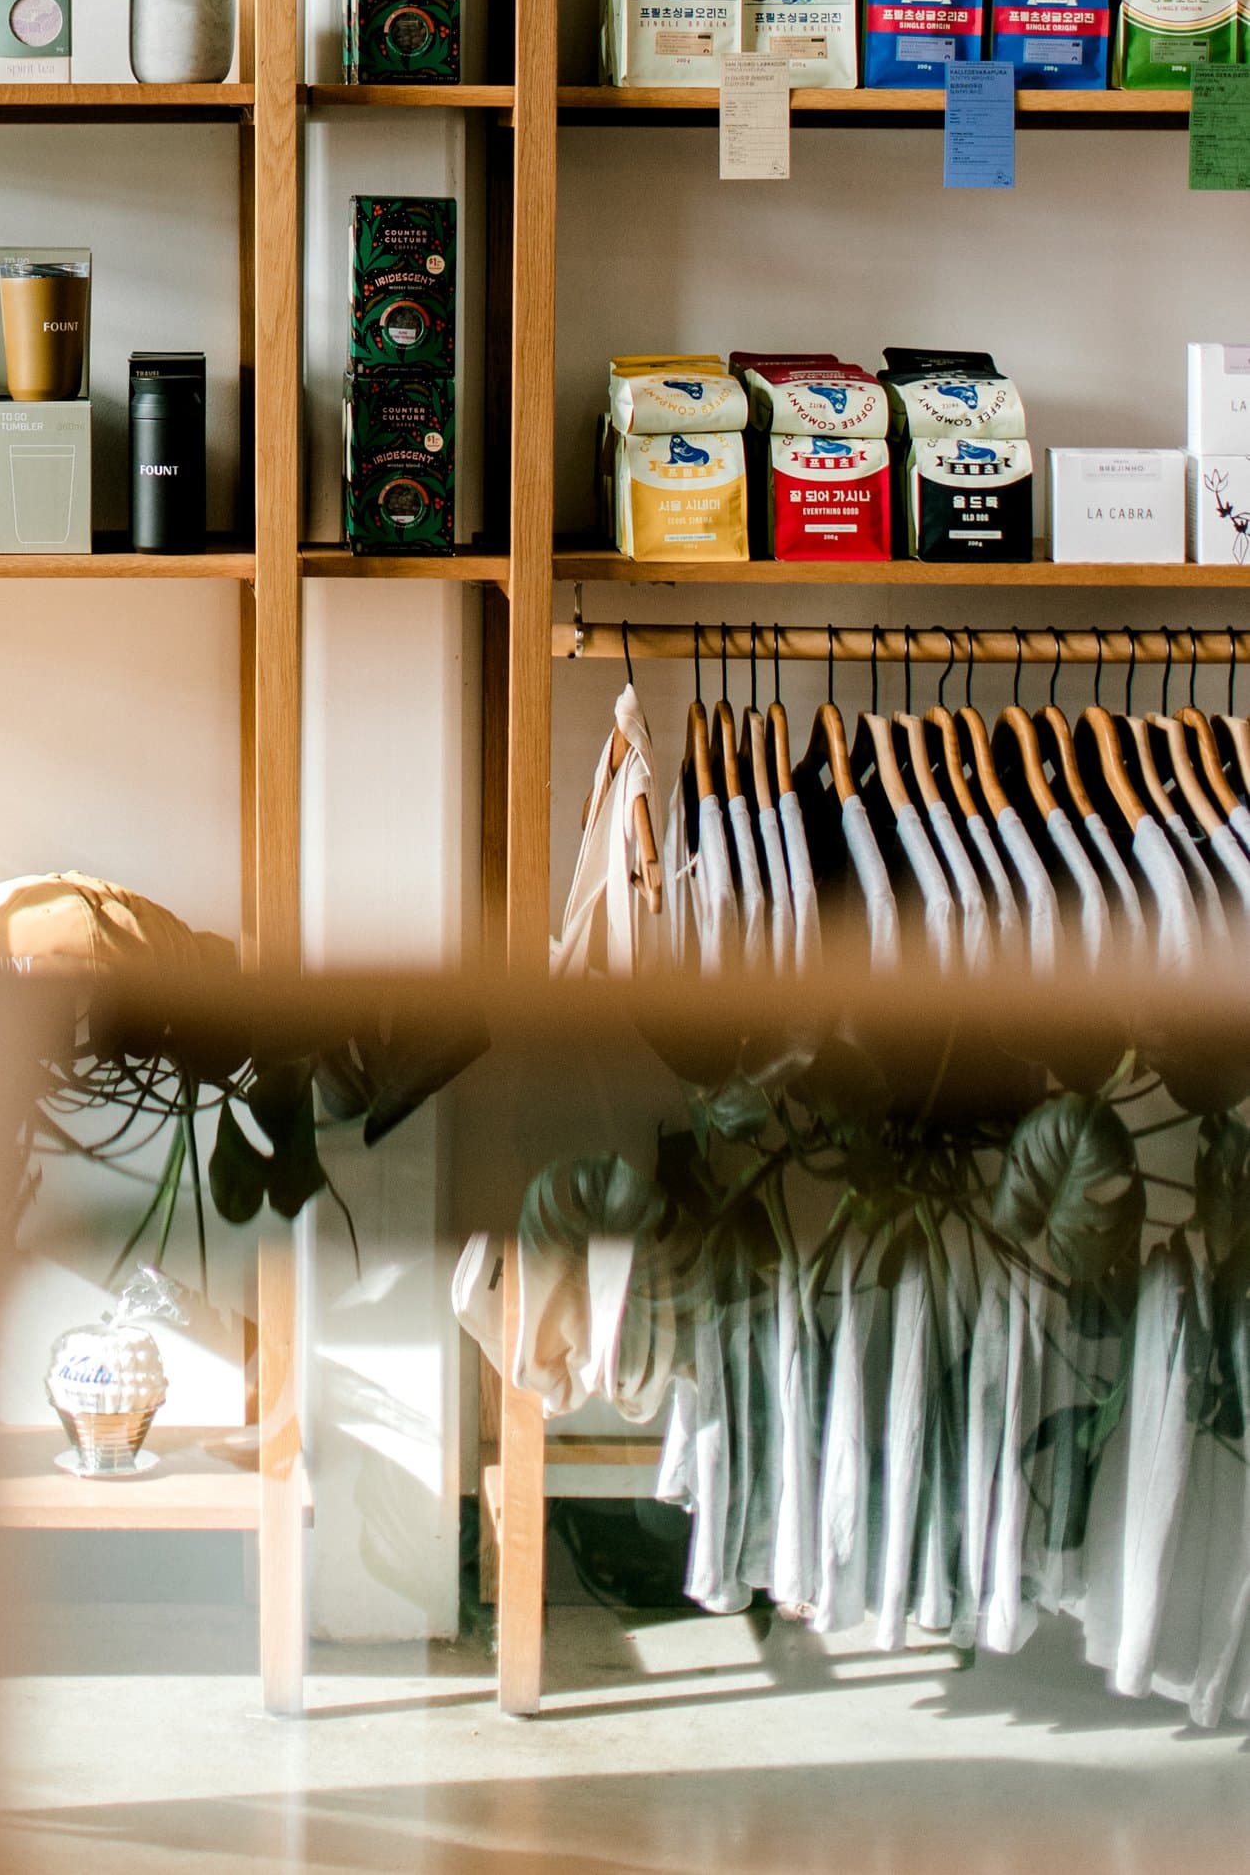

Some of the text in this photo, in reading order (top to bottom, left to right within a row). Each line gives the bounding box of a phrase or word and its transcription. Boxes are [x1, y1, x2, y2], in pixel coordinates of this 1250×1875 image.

[754, 25, 841, 33] SINGLE ORIGIN
[374, 273, 436, 287] IRIDESCENT
[43, 321, 78, 333] FOUNT
[786, 391, 877, 431] COFFEE COMPANY
[918, 391, 1007, 427] COFFEE COMPANY
[1230, 400, 1246, 412] LA
[1, 413, 27, 421] TO GO
[1, 423, 44, 431] TUMBLER
[372, 451, 434, 465] IRIDESCENT
[140, 465, 180, 476] FOUNT
[790, 489, 871, 503] 잘 되어 가시나
[802, 507, 860, 515] EVERYTHING GOOD
[1087, 507, 1154, 519] LA CABRA
[962, 513, 975, 522] OLD
